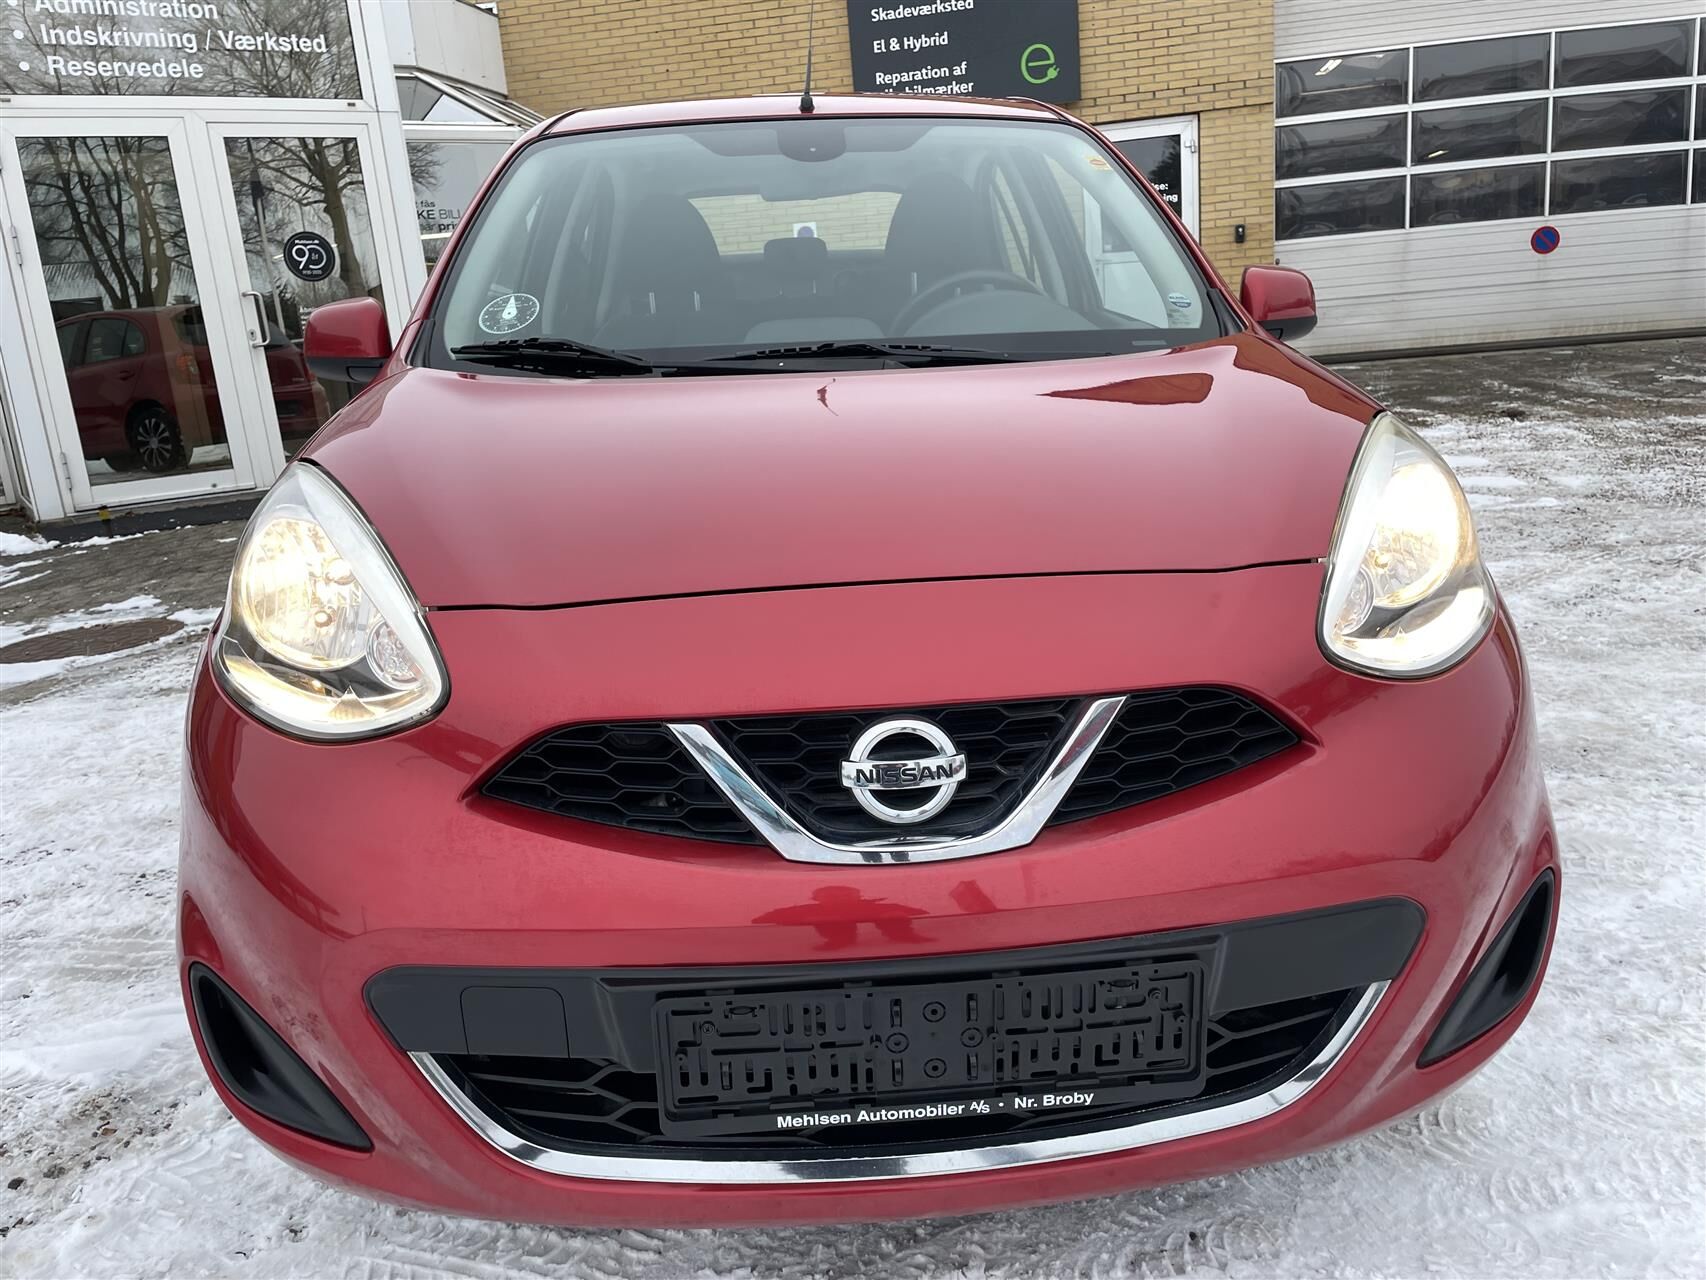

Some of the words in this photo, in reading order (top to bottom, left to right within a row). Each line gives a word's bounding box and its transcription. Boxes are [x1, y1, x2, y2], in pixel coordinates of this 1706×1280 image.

[35, 0, 218, 19] Administration
[871, 0, 974, 21] Skadeværksted
[40, 24, 198, 54] Indskrivning
[217, 30, 327, 53] Værksted
[873, 39, 886, 53] El
[889, 38, 901, 51] &
[903, 31, 948, 52] Hybrid
[46, 55, 204, 78] Reservedele
[875, 65, 949, 86] Reparation
[953, 61, 967, 76] af
[855, 763, 954, 784] NISSAN
[776, 1112, 851, 1129] Mehlsen
[857, 1102, 965, 1122] Automobiler
[1014, 1096, 1038, 1109] Nr.
[1043, 1092, 1095, 1107] Broby
